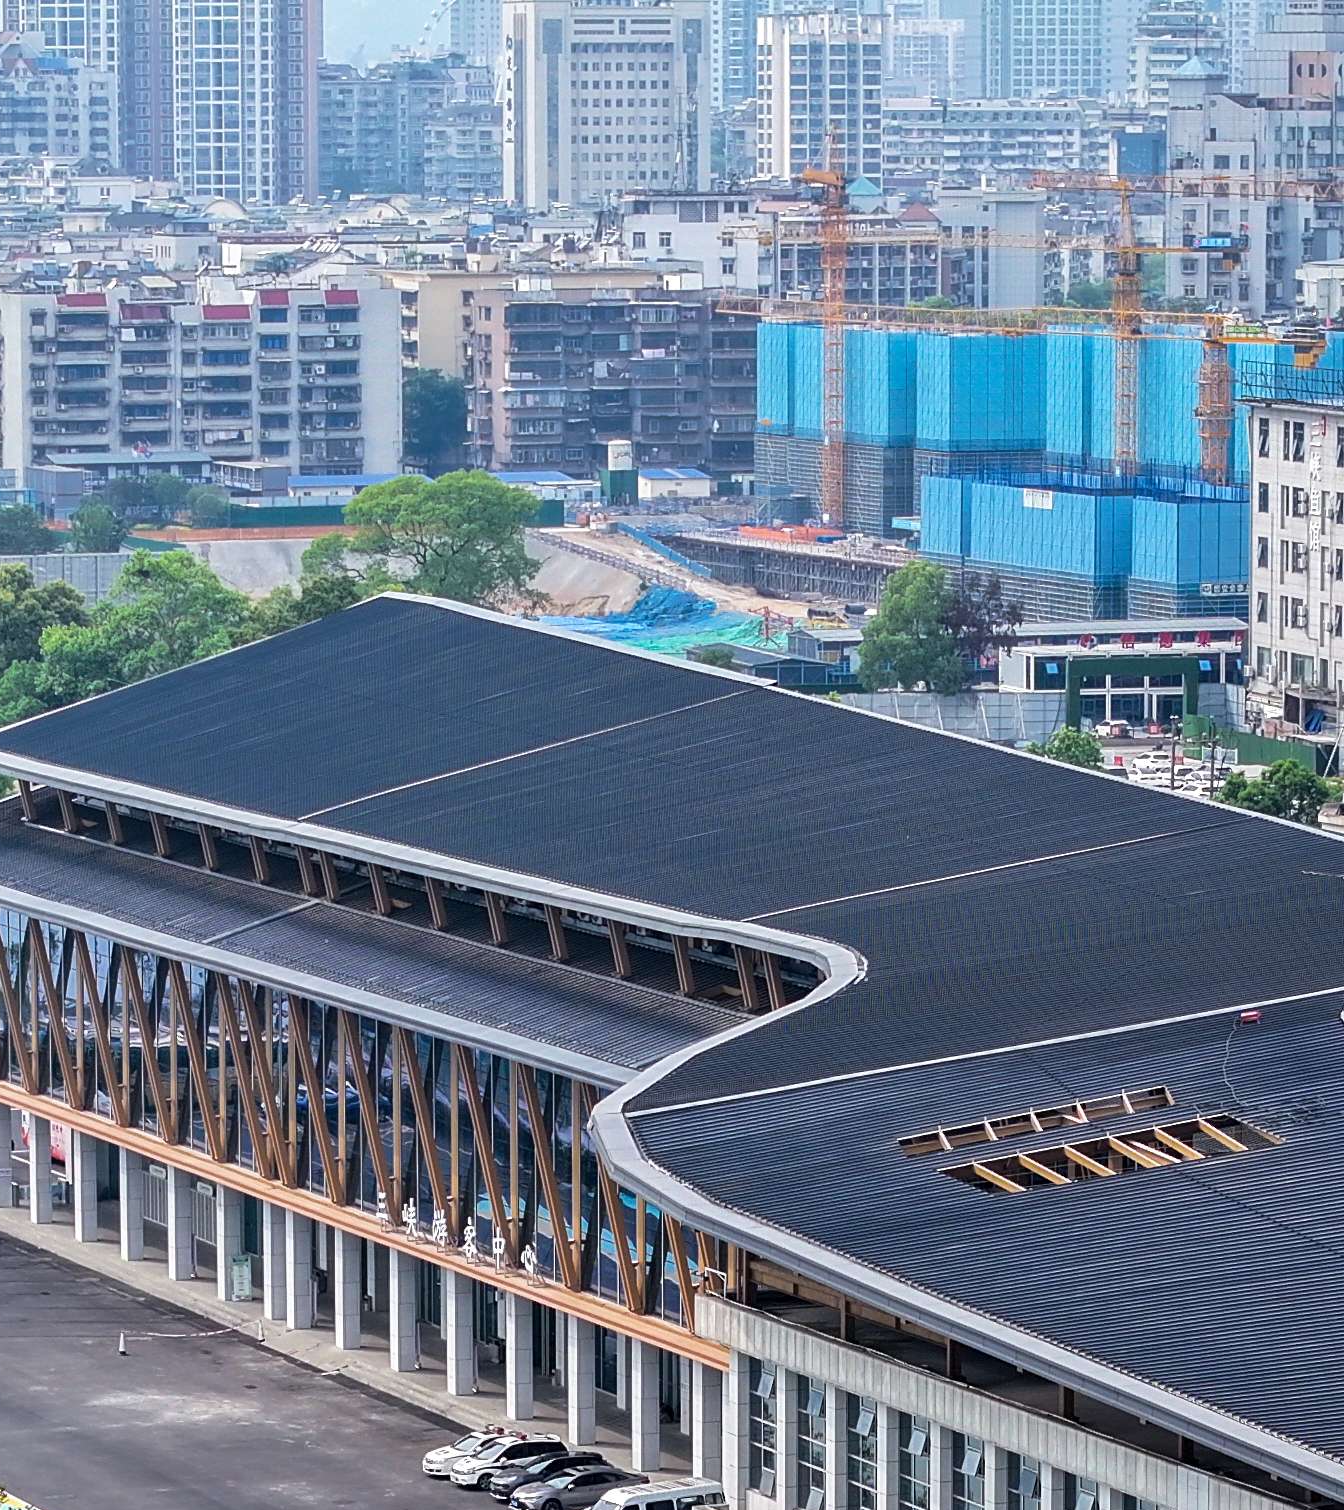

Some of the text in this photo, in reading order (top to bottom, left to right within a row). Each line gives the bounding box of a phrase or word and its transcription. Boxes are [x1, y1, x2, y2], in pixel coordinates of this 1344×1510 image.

[375, 1191, 538, 1274] 三峡游客中心
